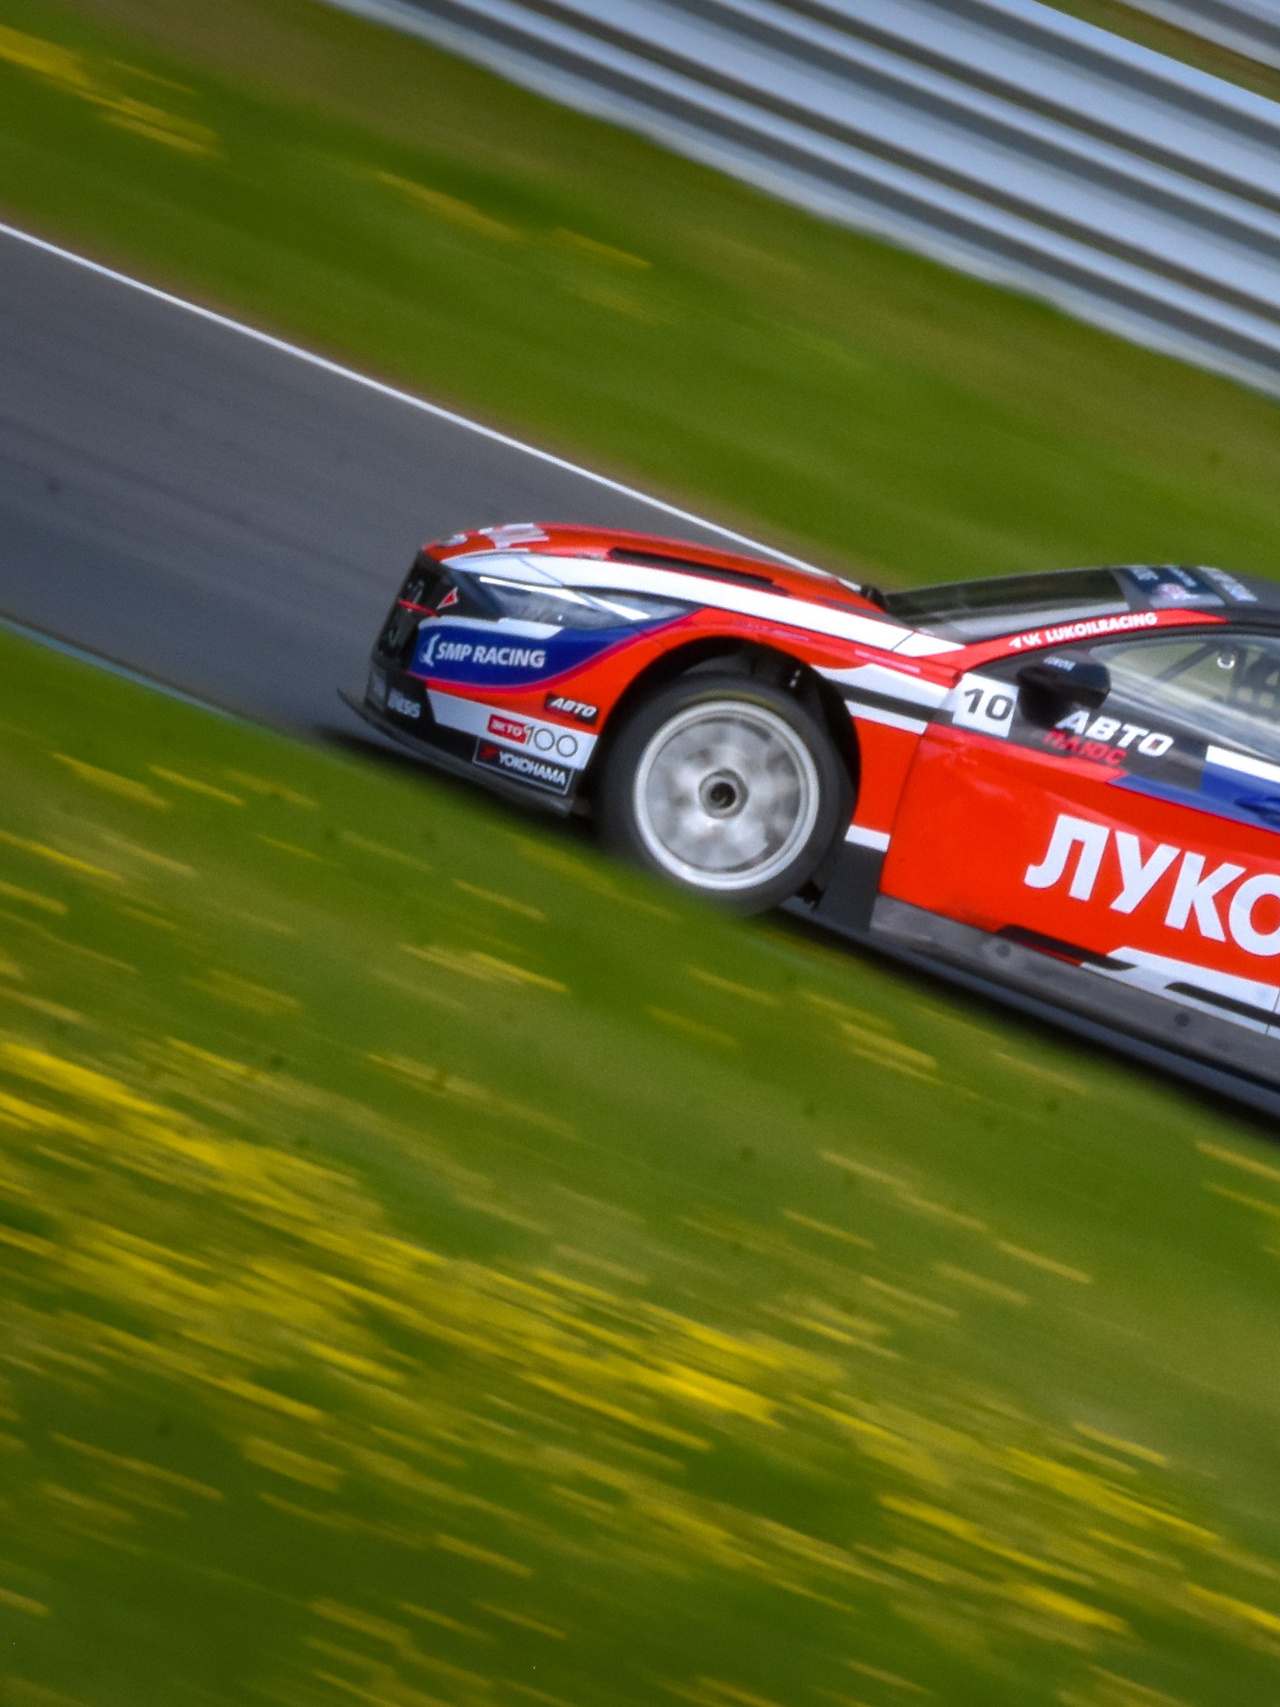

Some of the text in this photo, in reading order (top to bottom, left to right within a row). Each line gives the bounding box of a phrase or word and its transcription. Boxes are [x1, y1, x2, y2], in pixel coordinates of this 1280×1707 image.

[1044, 611, 1158, 643] LUKOILRACING
[436, 641, 547, 669] SMP RACING
[963, 687, 1014, 722] 10
[1054, 709, 1175, 758] АВТО
[498, 751, 567, 786] YOKOHAMA
